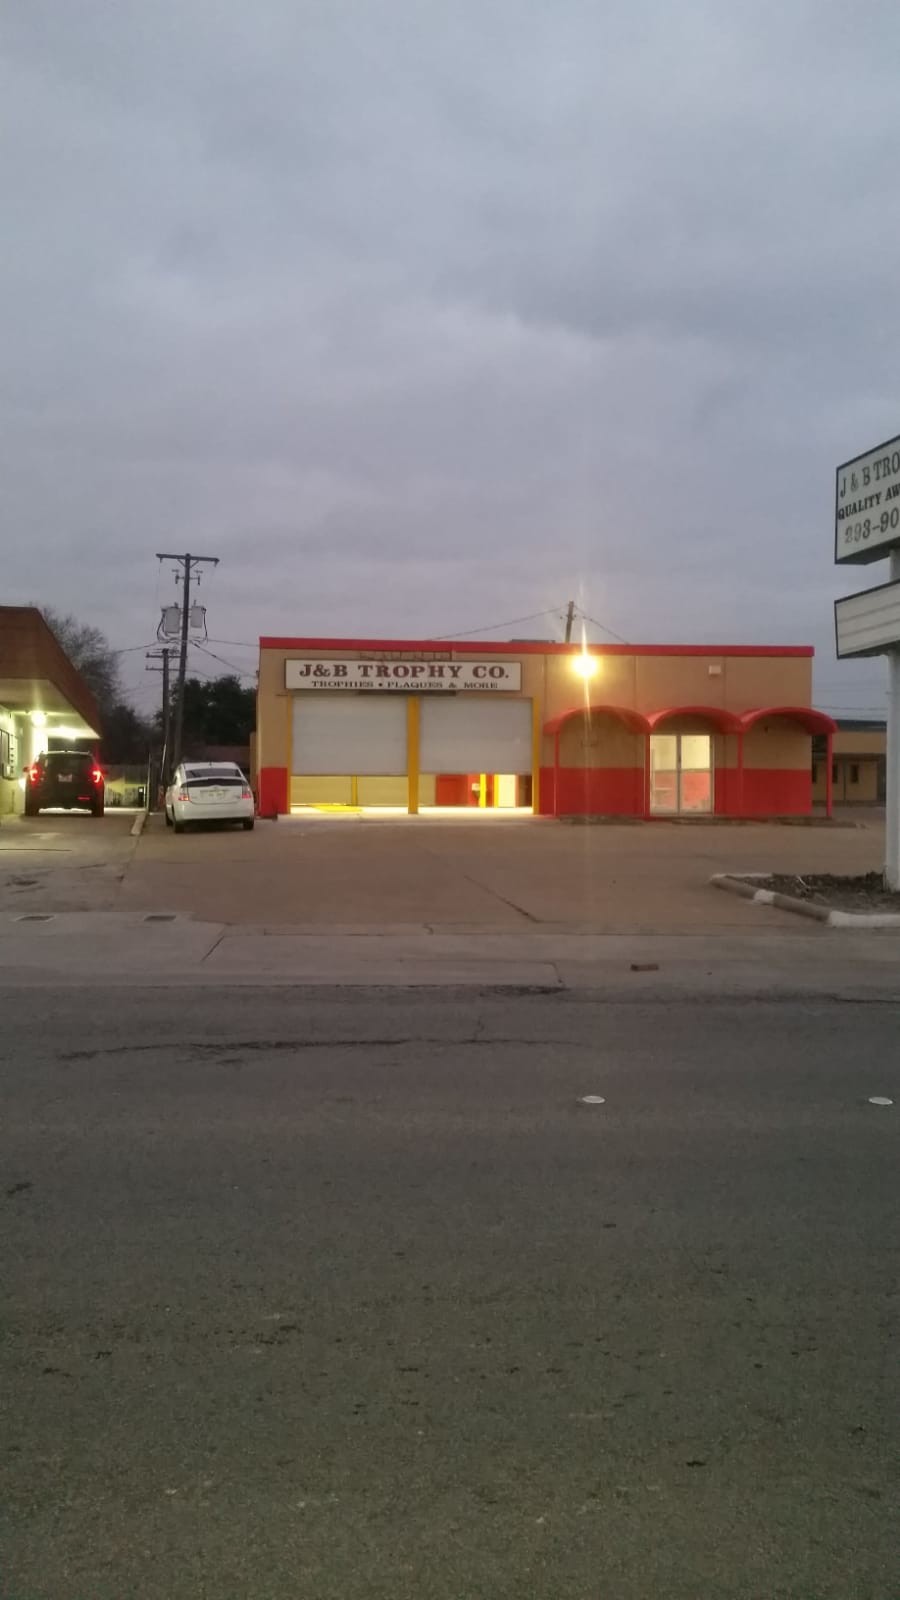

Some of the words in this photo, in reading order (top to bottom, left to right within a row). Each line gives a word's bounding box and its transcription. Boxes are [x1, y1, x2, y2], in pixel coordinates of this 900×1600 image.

[840, 478, 846, 497] J
[850, 471, 859, 492] &
[862, 465, 871, 487] B
[872, 451, 900, 481] TRO
[838, 491, 881, 520] QUALITY
[884, 483, 900, 501] AW
[299, 663, 348, 678] J&B
[358, 665, 463, 678] TROPHY
[472, 665, 510, 679] CO.
[387, 681, 443, 689] PLAQUES
